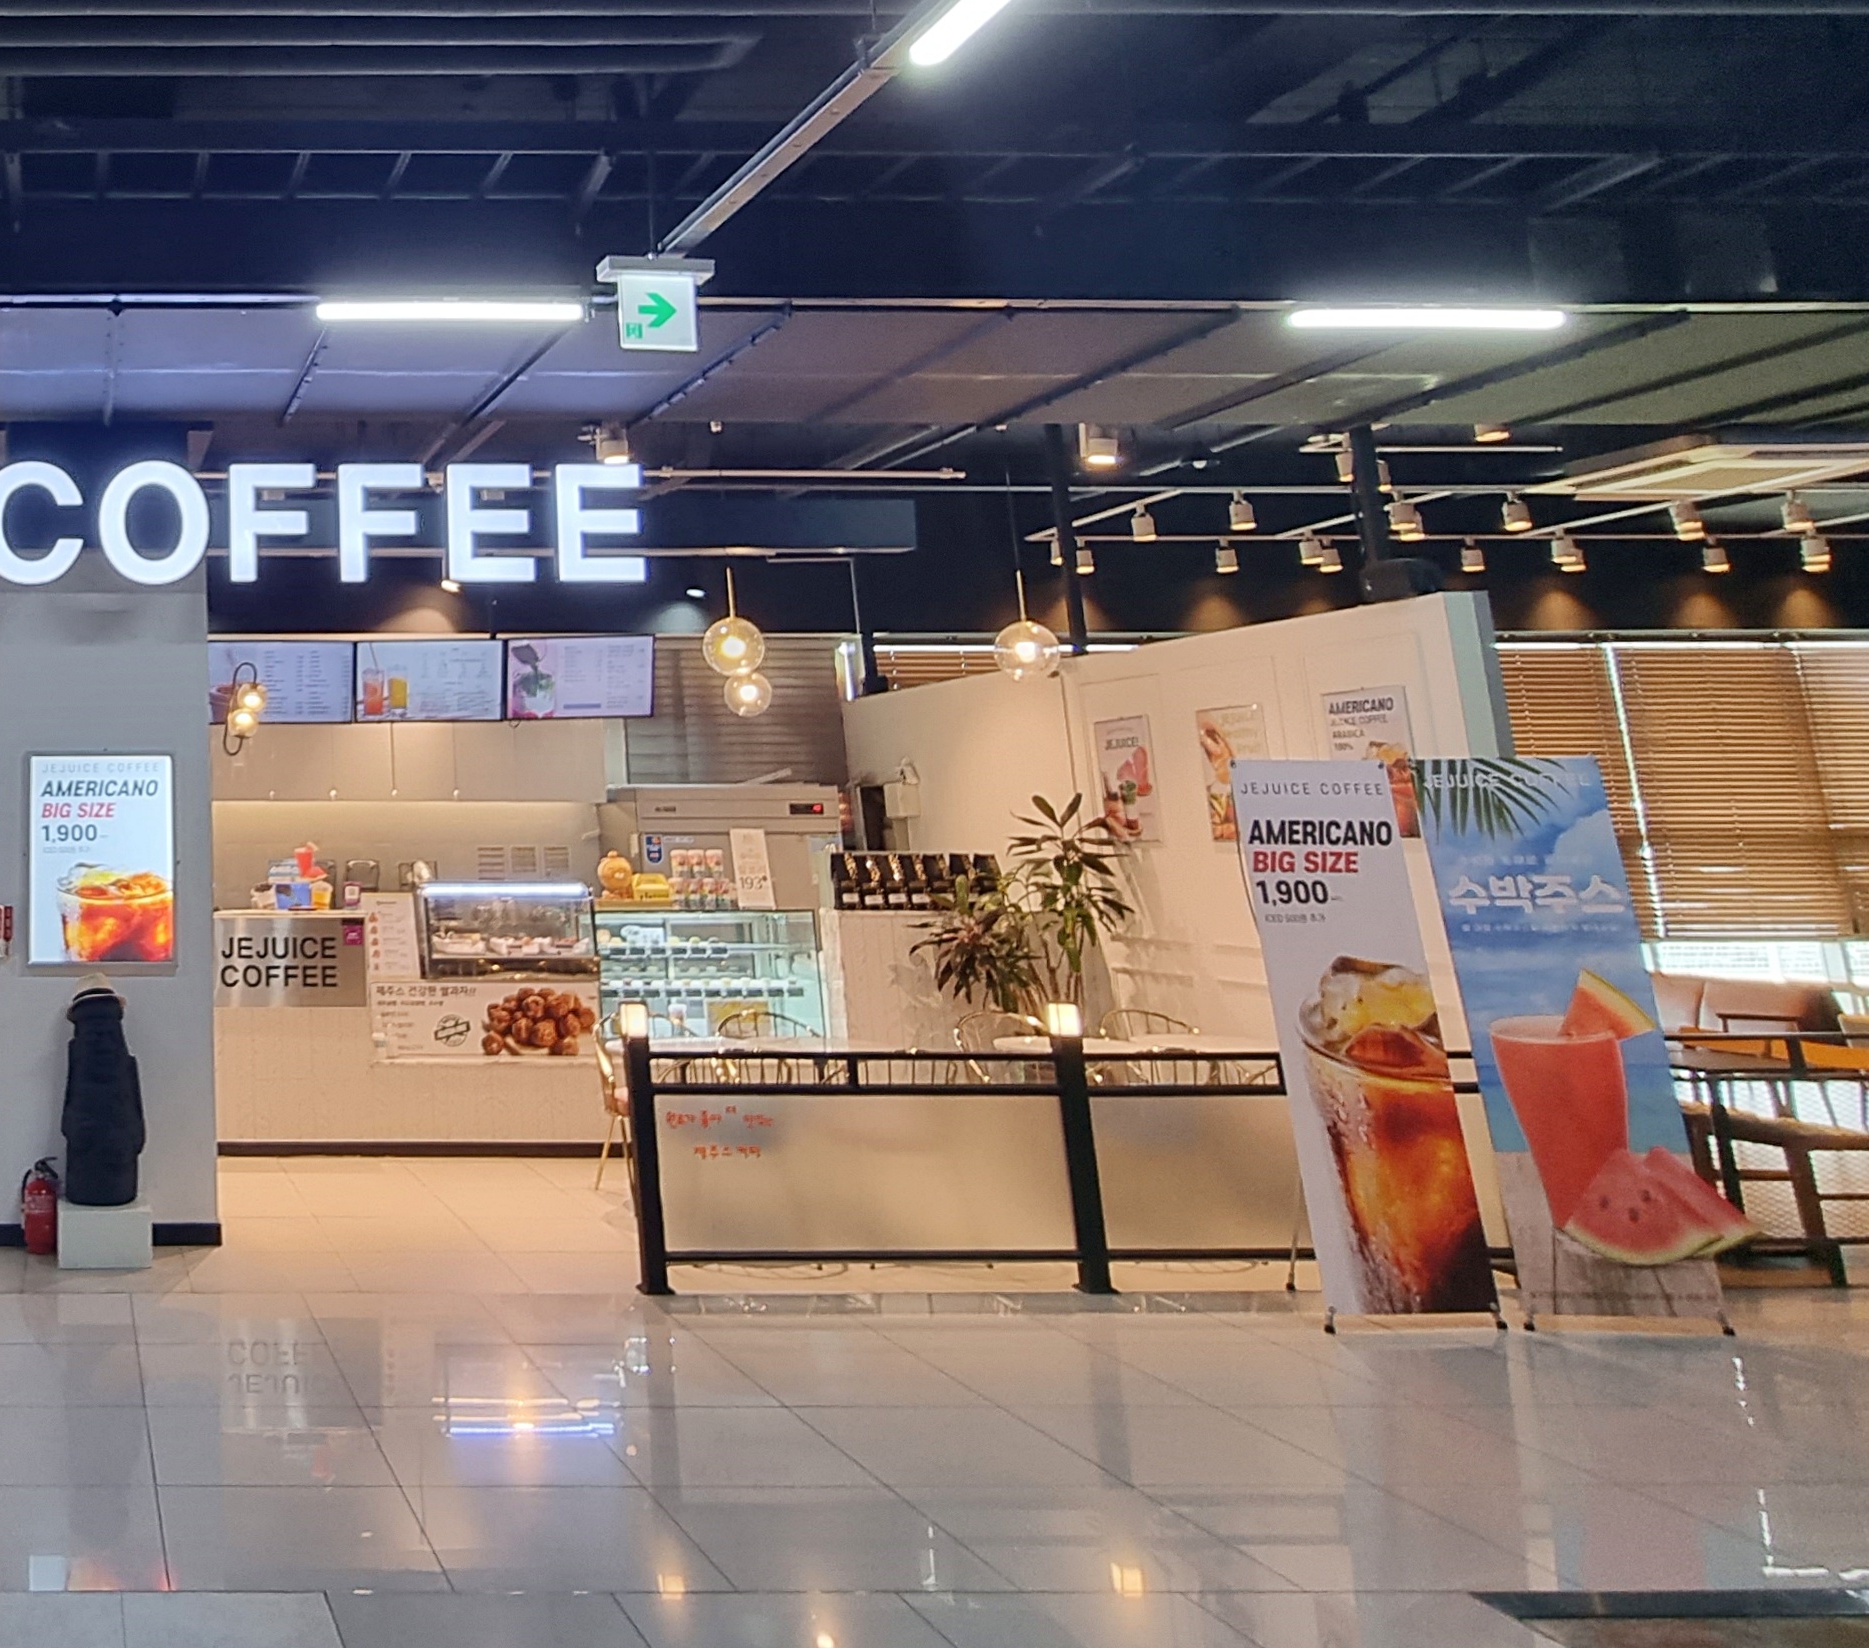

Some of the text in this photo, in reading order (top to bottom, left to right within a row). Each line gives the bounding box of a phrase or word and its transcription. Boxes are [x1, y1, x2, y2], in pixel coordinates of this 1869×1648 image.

[1328, 696, 1394, 716] AMERICANO
[42, 762, 159, 774] JEJUICE COFFEE
[40, 779, 159, 797] AMERICANO
[1241, 781, 1384, 796] JEJUICE COFFEE
[41, 802, 116, 818] BIG SIZE
[1248, 819, 1392, 847] AMERICANO
[1252, 851, 1359, 874] BIG SIZE
[1256, 880, 1329, 907] 1,900
[1448, 874, 1626, 915] 수박주스
[221, 936, 337, 960] JEJUICE
[221, 964, 338, 988] COFFEE
